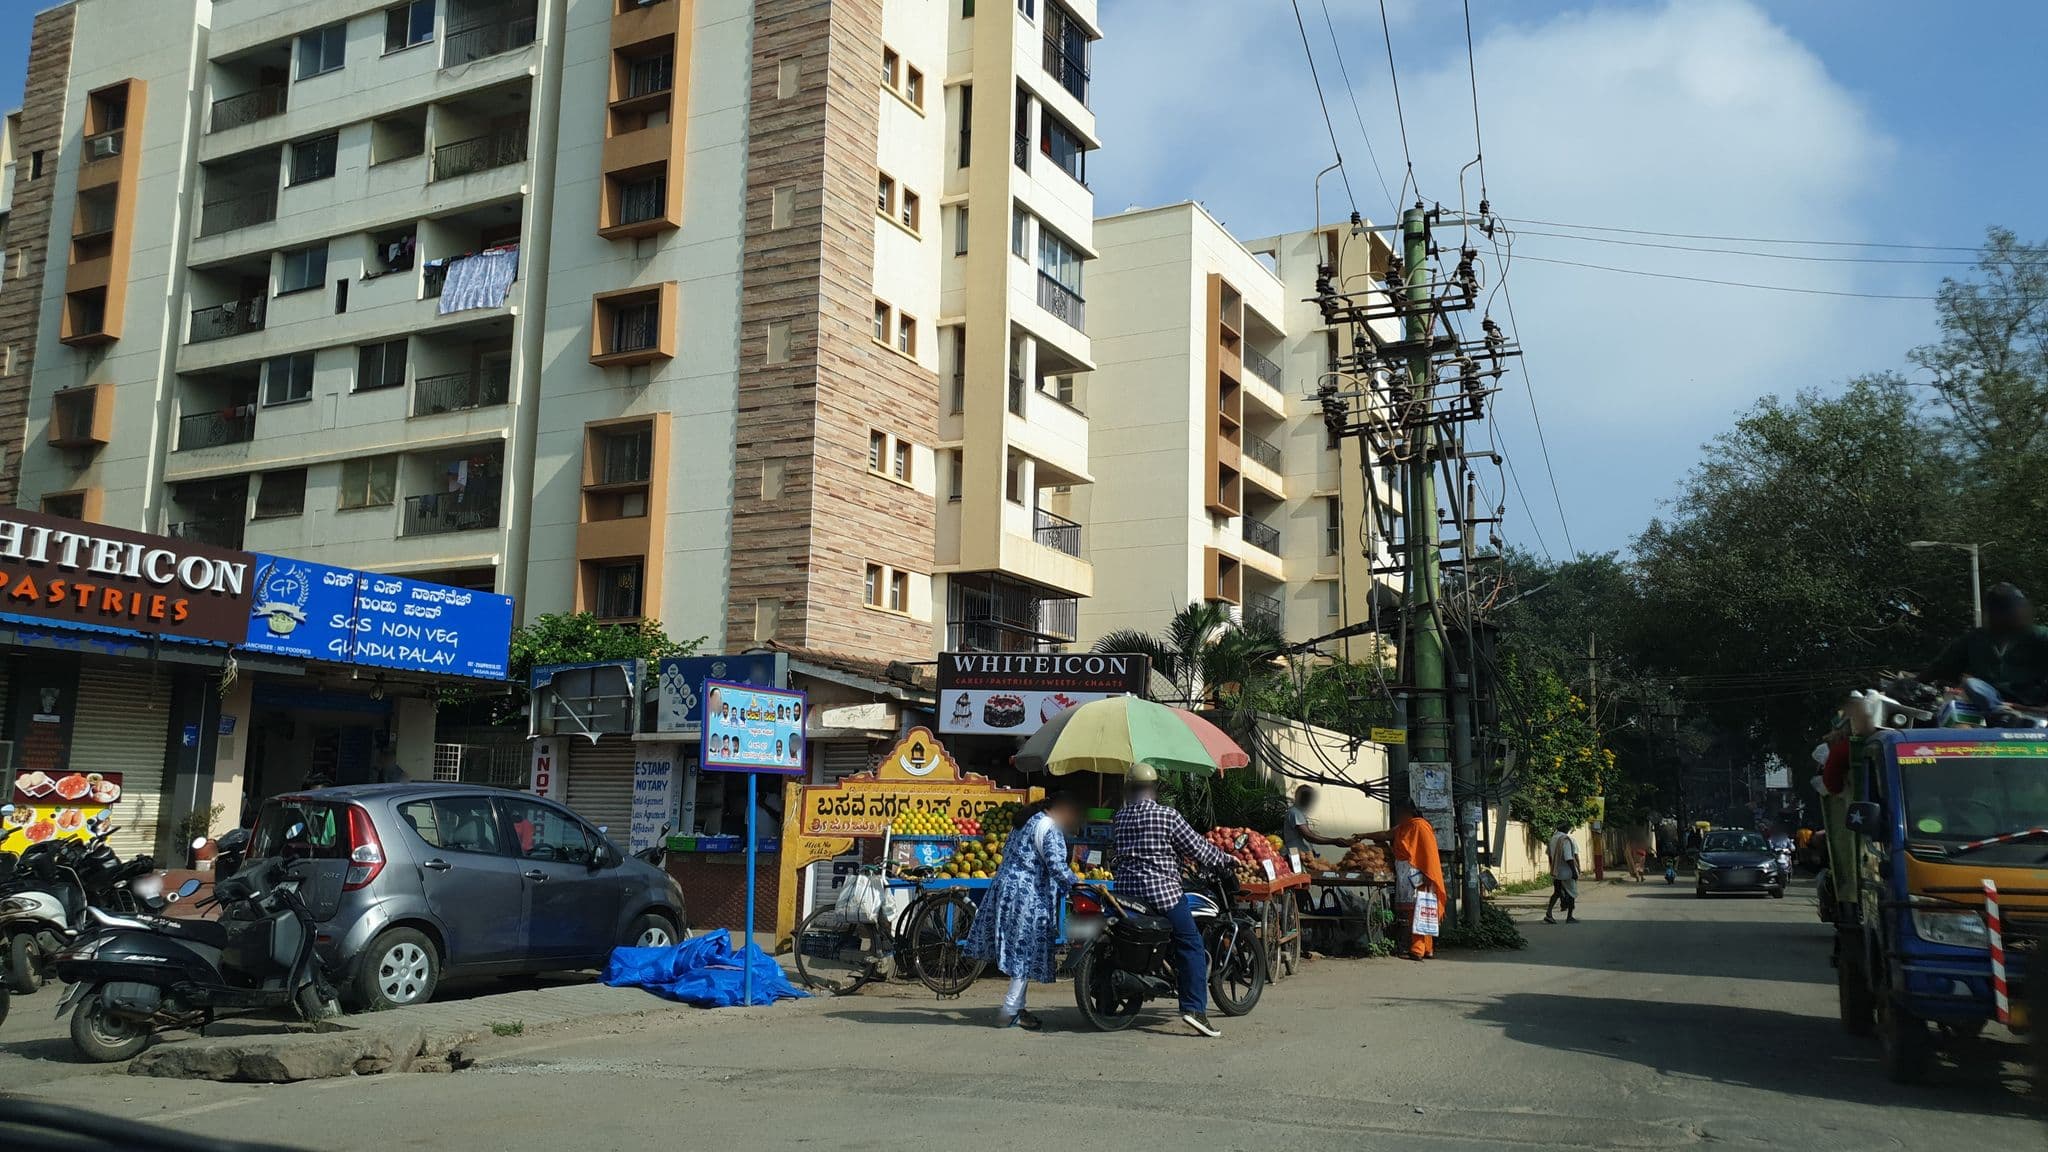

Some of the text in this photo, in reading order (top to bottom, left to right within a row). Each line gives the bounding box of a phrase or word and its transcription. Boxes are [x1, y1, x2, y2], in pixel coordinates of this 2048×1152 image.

[381, 621, 421, 641] NON
[424, 628, 460, 648] VEG
[398, 646, 456, 666] PALAV
[953, 655, 1129, 675] WHITEICON
[636, 779, 669, 792] NOTARY
[817, 793, 866, 817] ಬಸವ
